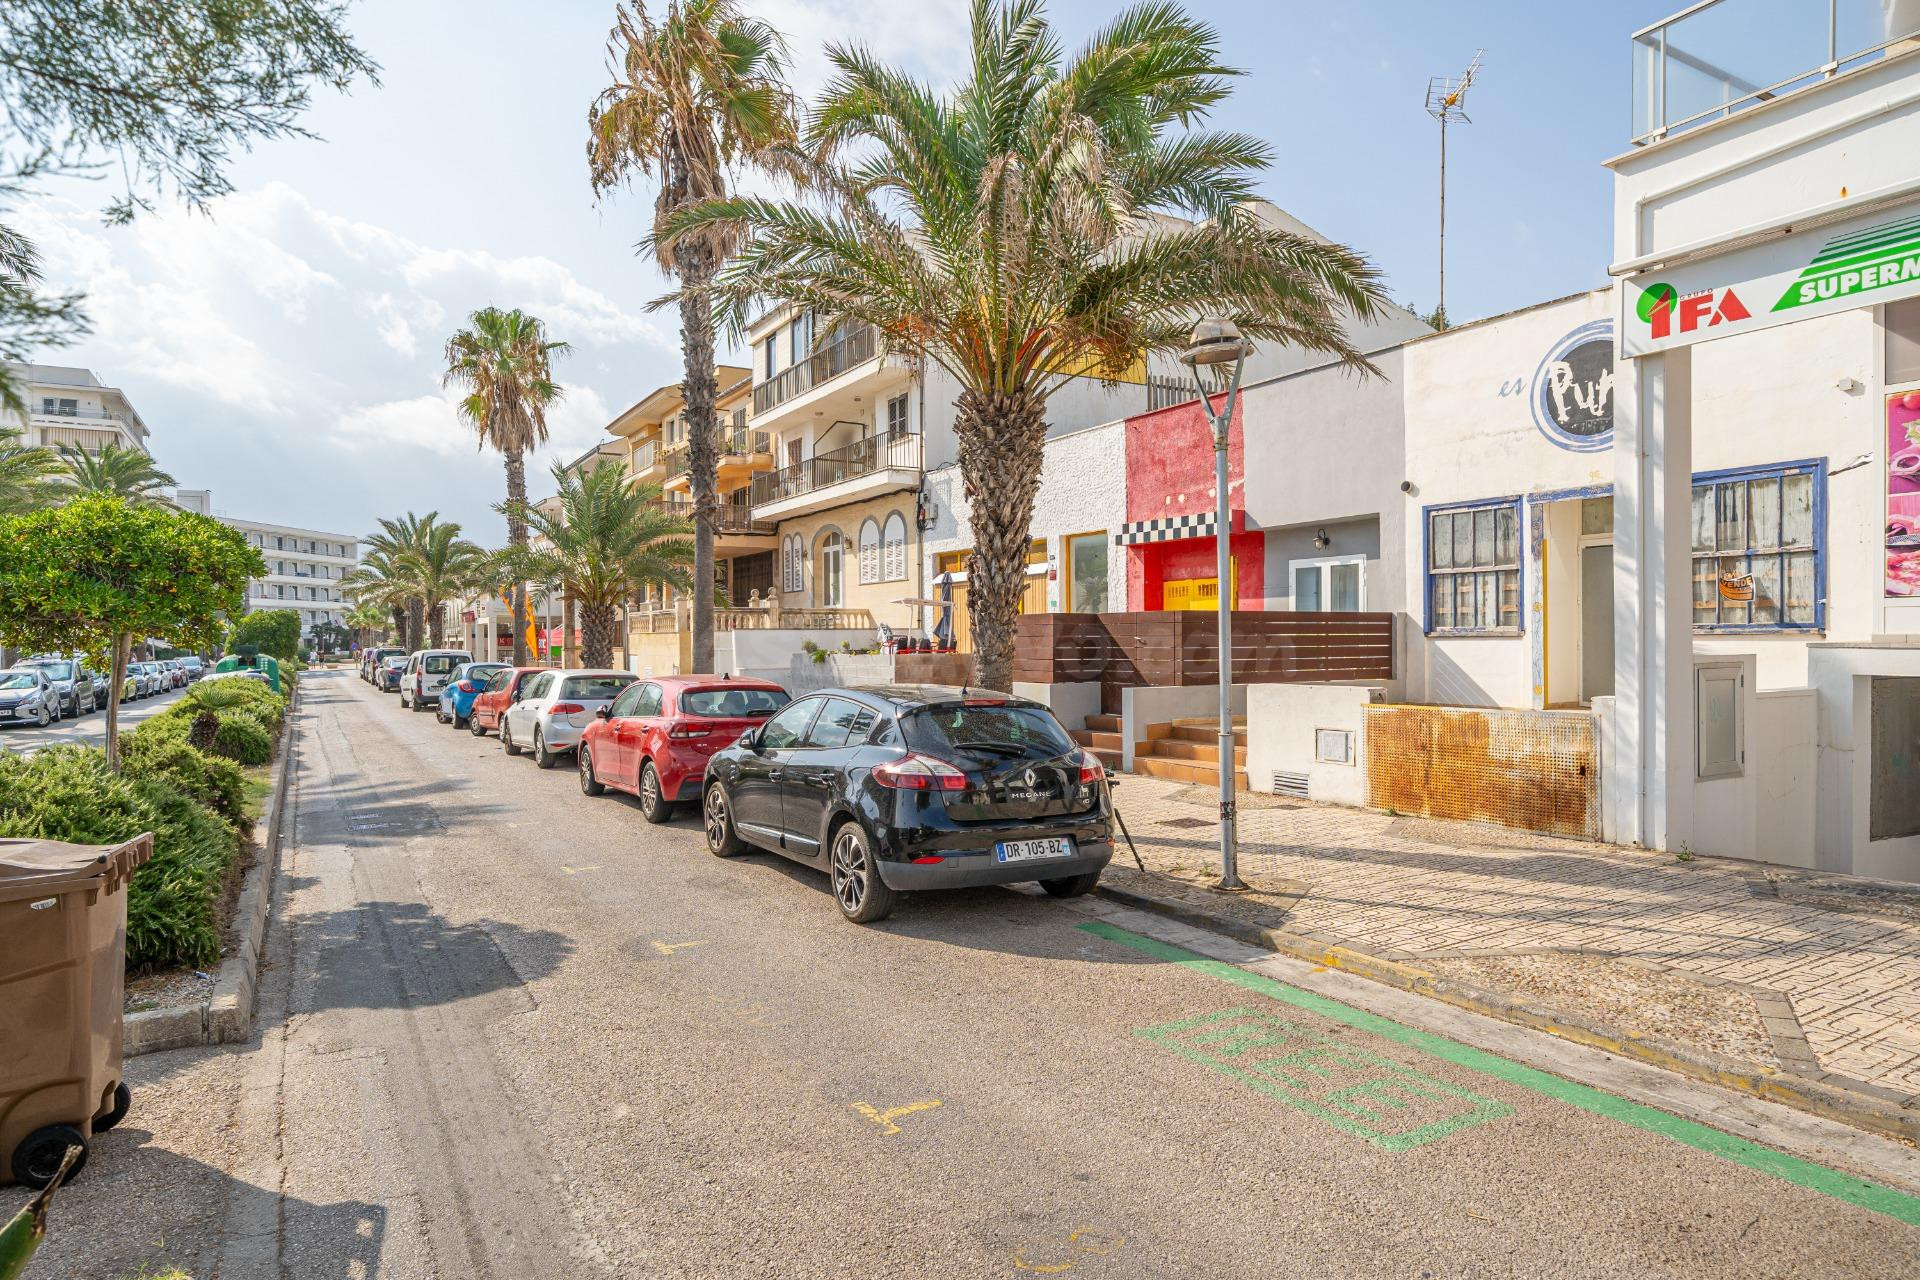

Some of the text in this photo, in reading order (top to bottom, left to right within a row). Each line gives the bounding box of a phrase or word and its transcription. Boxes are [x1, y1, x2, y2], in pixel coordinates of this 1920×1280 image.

[1679, 287, 1714, 301] GRUPO
[1722, 576, 1752, 588] VENDE
[1011, 791, 1052, 799] MEGANE
